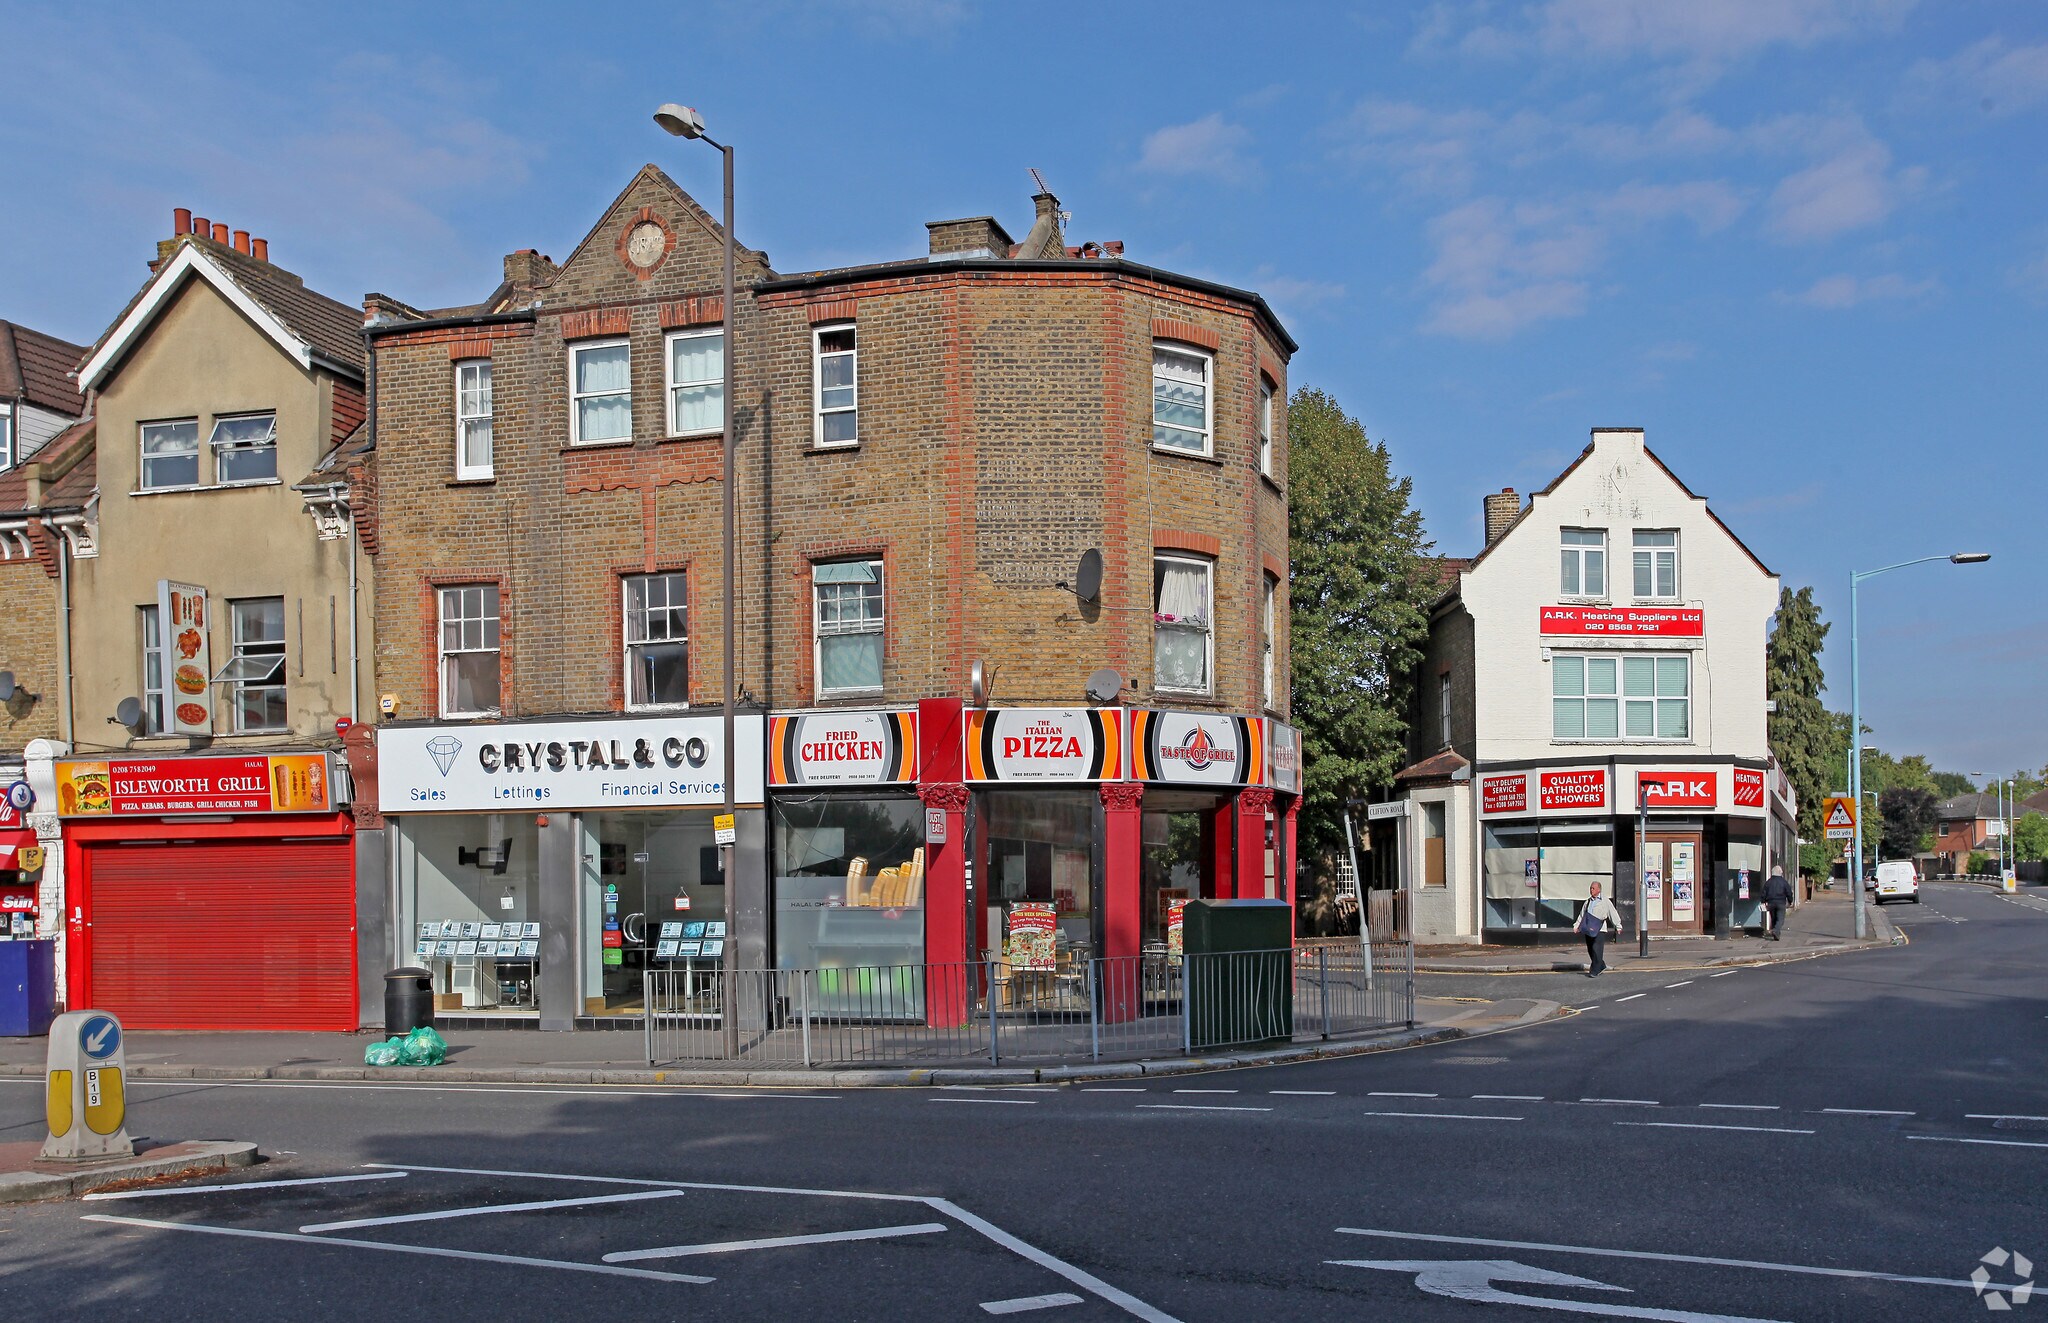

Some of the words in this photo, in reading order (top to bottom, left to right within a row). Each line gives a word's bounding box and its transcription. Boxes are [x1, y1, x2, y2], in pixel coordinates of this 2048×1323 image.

[1544, 611, 1577, 619] A.R.K.
[1582, 612, 1624, 622] Heating
[1629, 613, 1677, 622] Suppliers
[1682, 613, 1700, 621] Ltd
[825, 731, 858, 741] FRIED
[1025, 727, 1062, 735] ITALIAN
[801, 741, 883, 762] CHICKEN
[1003, 736, 1083, 759] PIZZA
[479, 740, 630, 773] CRYSTAL
[633, 738, 656, 769] &
[662, 736, 710, 768] CO
[1160, 745, 1190, 759] TASTE
[1194, 747, 1207, 760] OF
[1208, 750, 1236, 762] GRILL
[112, 766, 128, 774] 0208
[1484, 780, 1500, 788] DAILY
[1500, 778, 1525, 786] DELIVERY
[1550, 775, 1595, 786] QUALITY
[1736, 773, 1760, 785] HEATING
[115, 778, 210, 795] ISLEWORTH
[217, 776, 266, 791] GRILL
[601, 781, 663, 796] Financial
[1492, 785, 1516, 794] SERVICE
[1541, 784, 1604, 795] BATHROOMS
[1646, 781, 1711, 797] A.R.K.
[410, 787, 446, 801] Sales
[494, 785, 551, 801] Lettings
[244, 800, 258, 808] FISH
[1555, 794, 1600, 804] SHOWERS
[1370, 807, 1390, 815] CLIFTON
[929, 813, 941, 823] JUST
[2, 895, 34, 909] Sun
